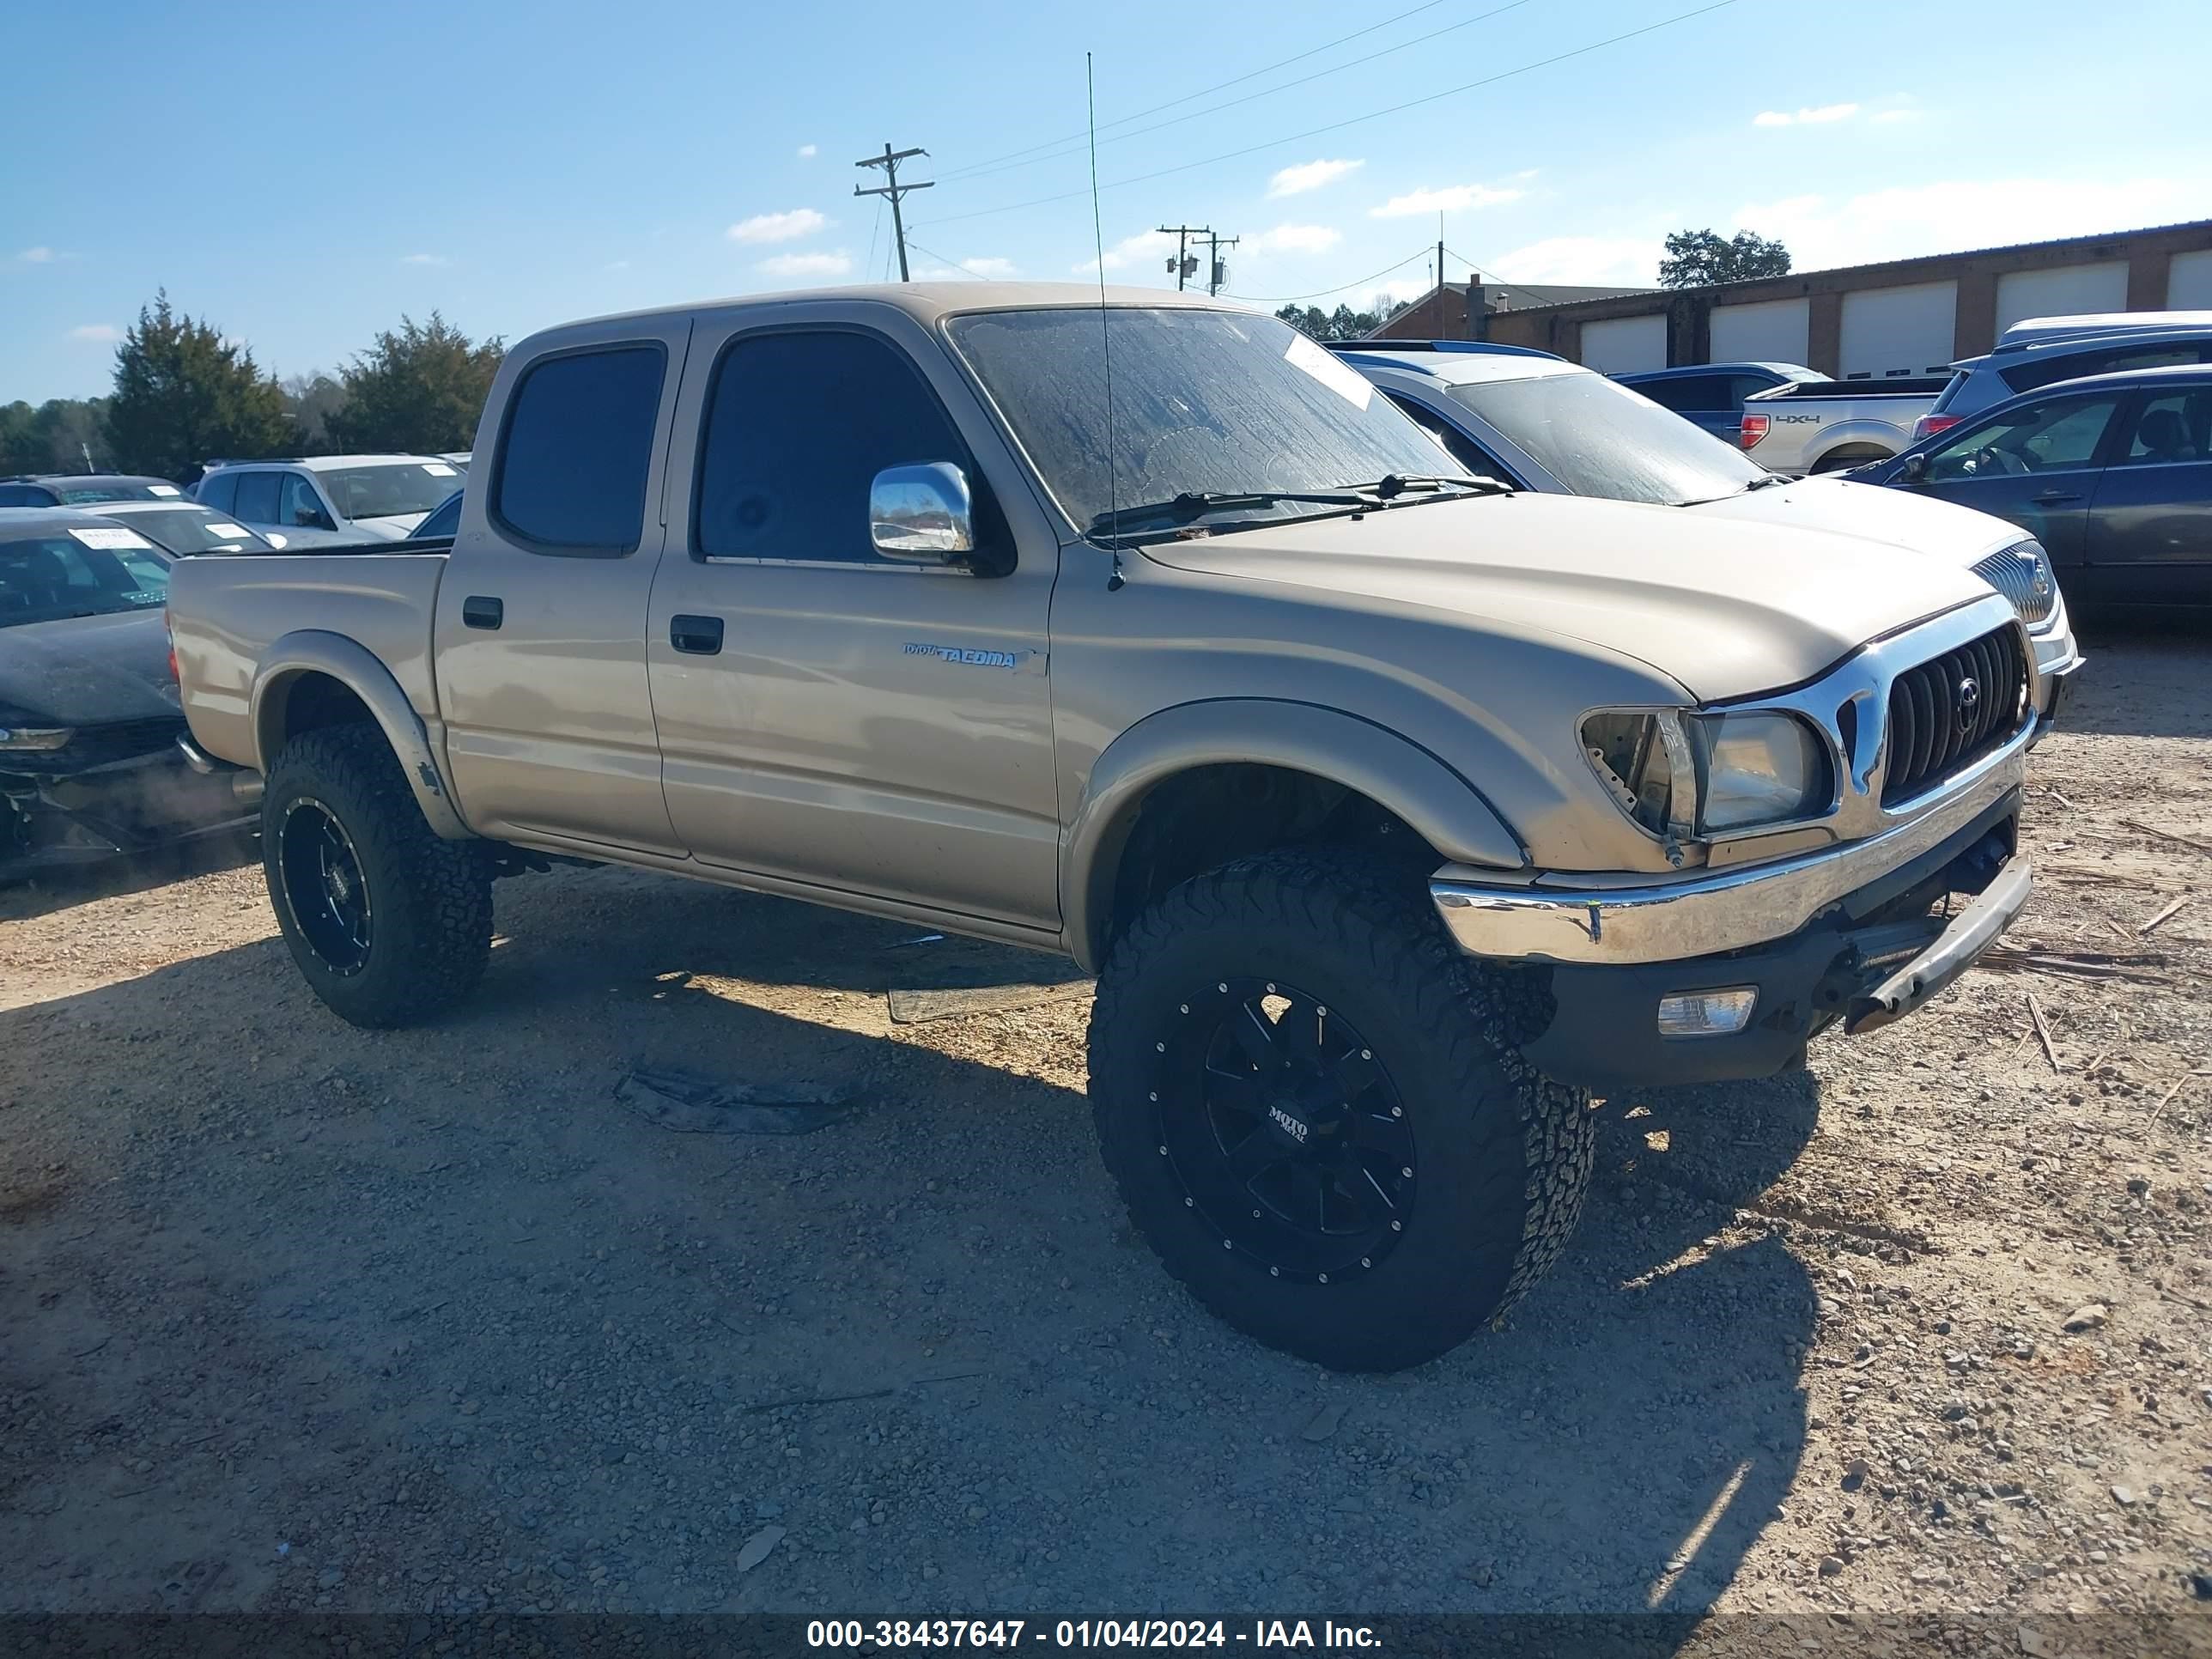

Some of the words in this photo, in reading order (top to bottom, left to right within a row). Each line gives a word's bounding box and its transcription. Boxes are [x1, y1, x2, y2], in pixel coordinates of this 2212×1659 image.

[902, 642, 938, 657] TOYOTA
[937, 647, 1015, 667] TACOMA
[1268, 1105, 1308, 1136] MOTO
[1280, 1122, 1305, 1144] METAL
